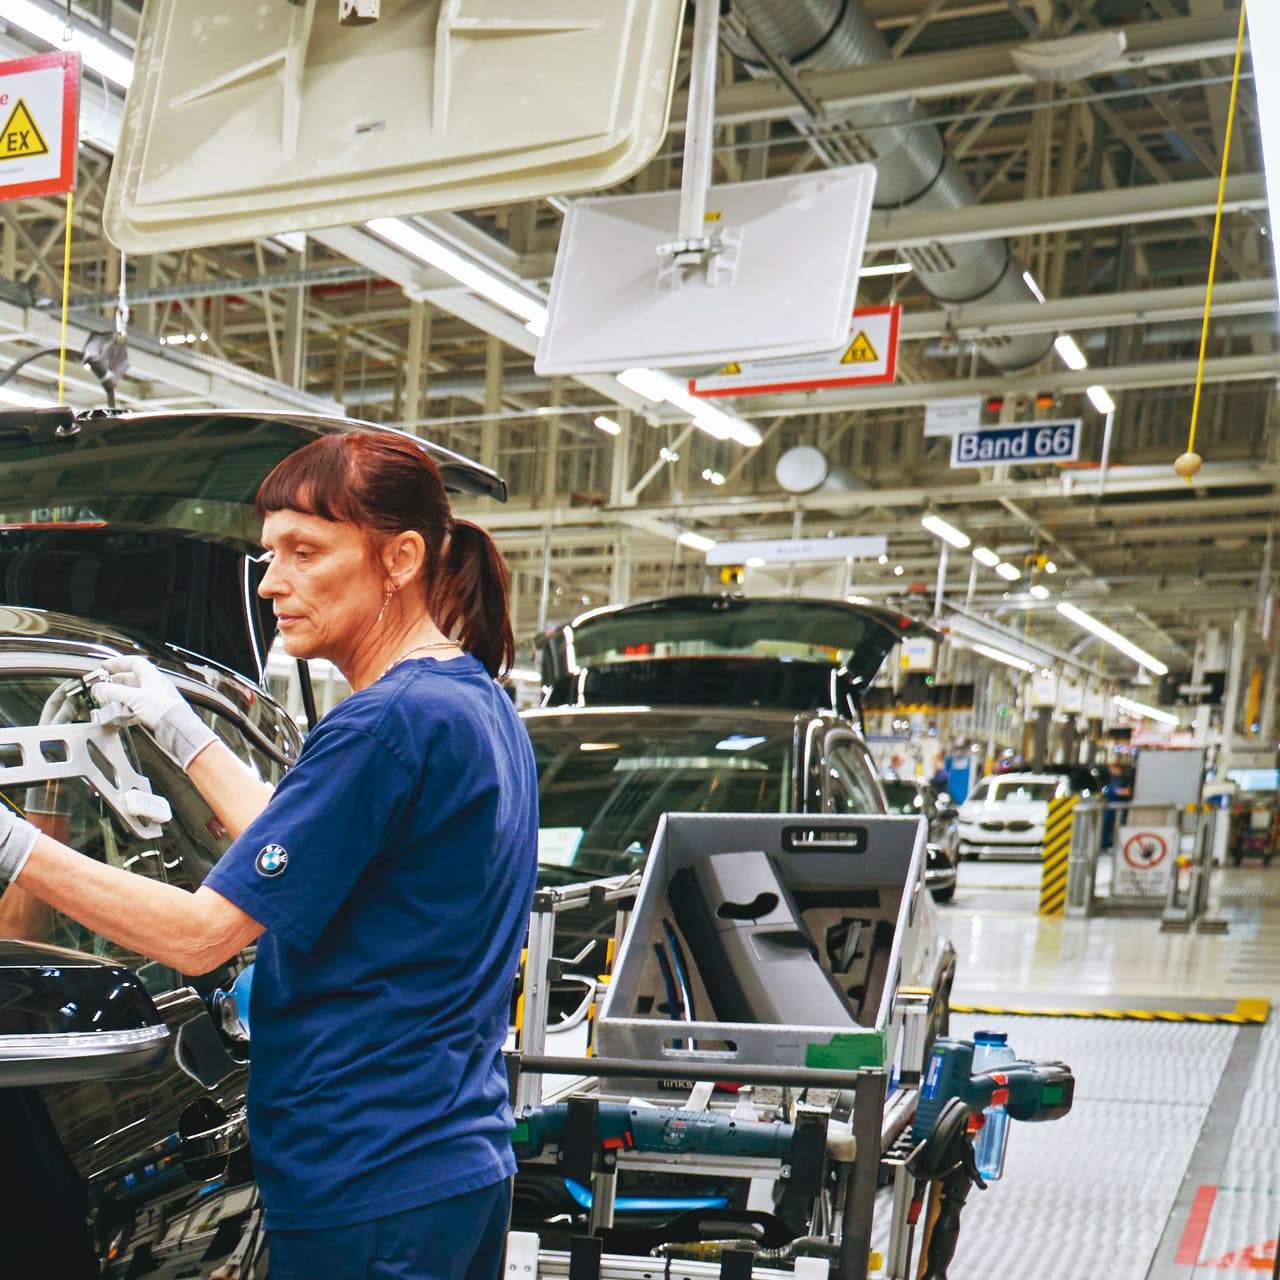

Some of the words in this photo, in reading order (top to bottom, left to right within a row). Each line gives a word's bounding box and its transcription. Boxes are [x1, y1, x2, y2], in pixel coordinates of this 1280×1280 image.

[7, 131, 30, 152] EX
[959, 430, 1028, 461] Band
[1034, 426, 1071, 455] 66
